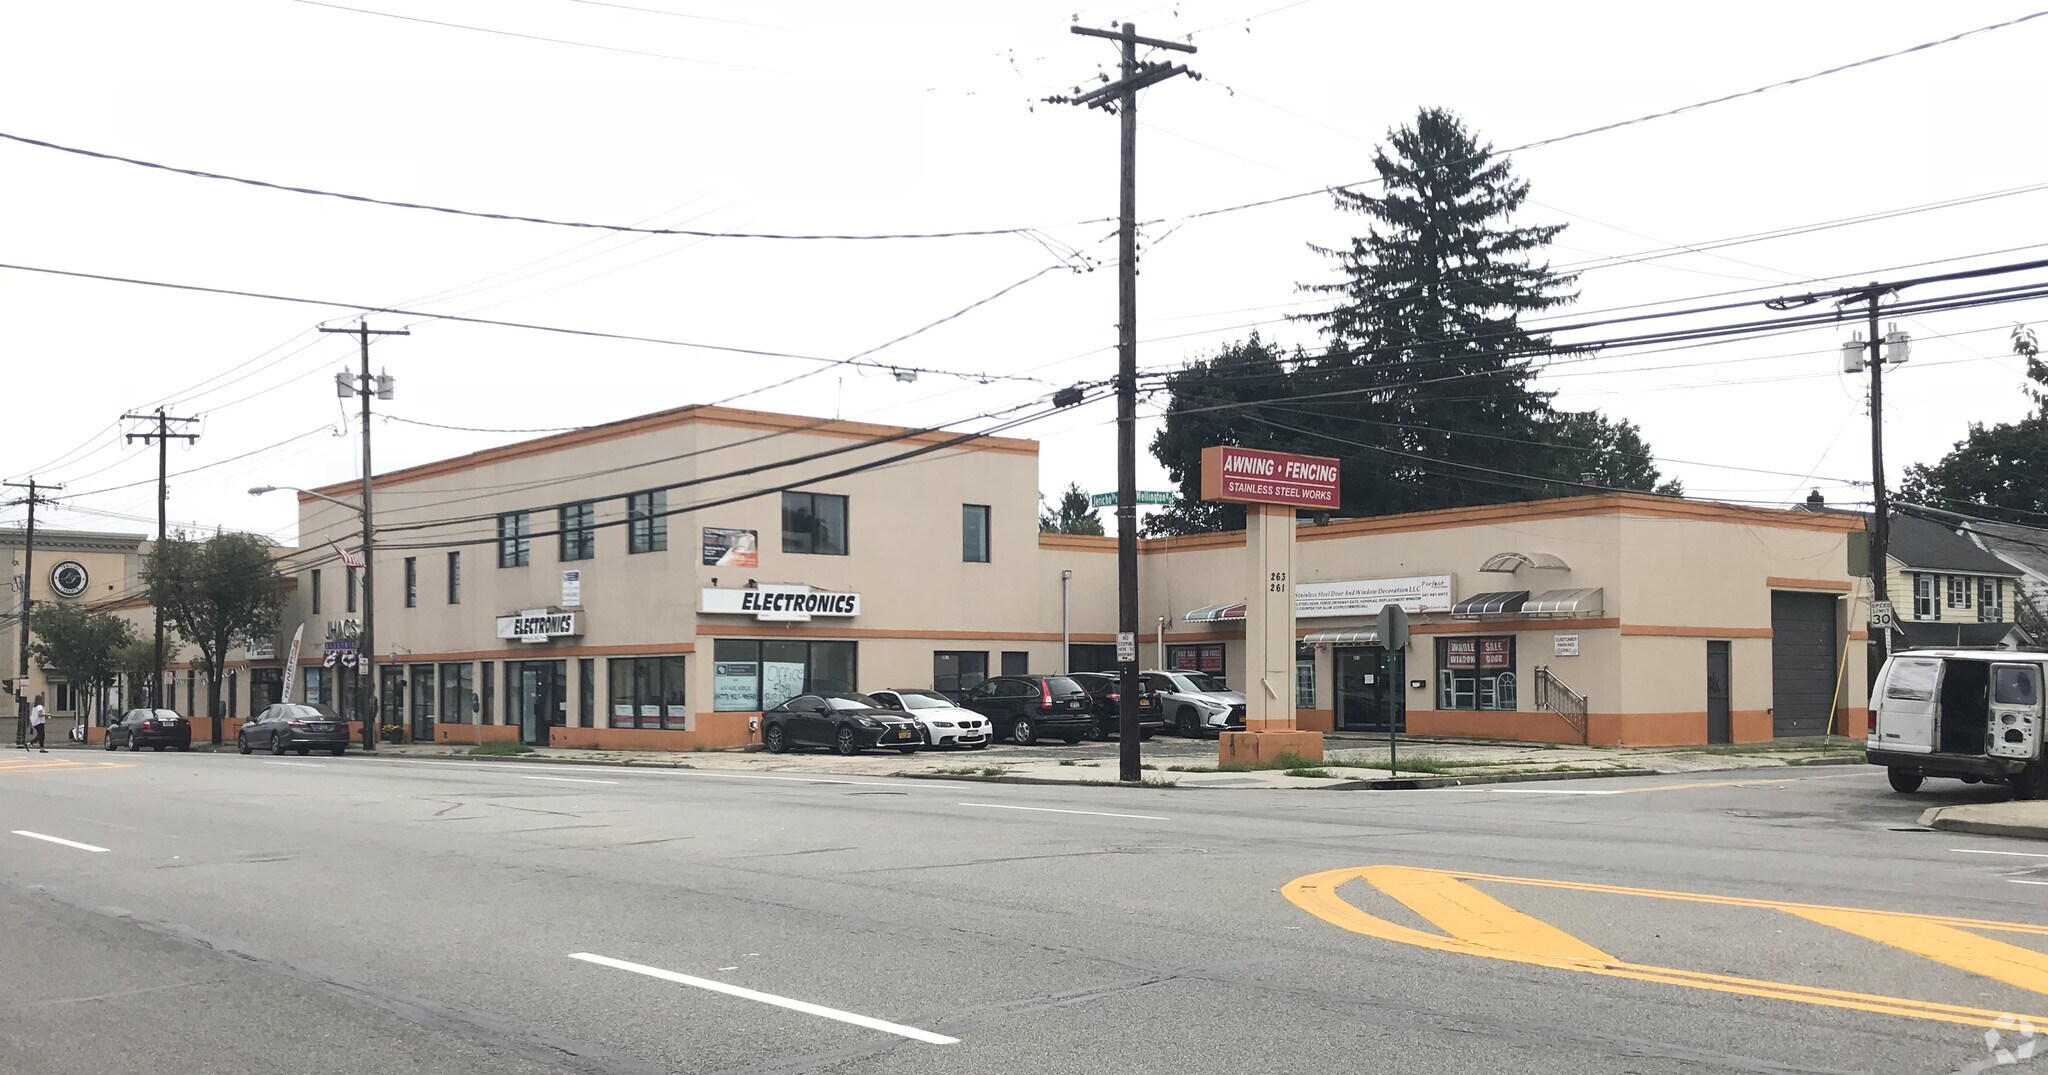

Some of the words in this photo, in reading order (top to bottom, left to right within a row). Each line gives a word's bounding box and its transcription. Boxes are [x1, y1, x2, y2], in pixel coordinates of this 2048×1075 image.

[1224, 455, 1274, 476] AWNING
[1285, 461, 1337, 482] FENCING
[1228, 482, 1273, 495] STAINLESS
[1275, 487, 1300, 498] STEEL
[1302, 489, 1331, 500] WORKS
[1093, 494, 1112, 506] Jericho
[1136, 491, 1166, 504] Wellington
[1270, 572, 1286, 581] 263
[1270, 584, 1285, 592] 261
[742, 592, 856, 613] ELECTRONICS
[514, 615, 572, 635] ELECTRONICS
[1872, 614, 1890, 624] 30
[1451, 642, 1475, 652] WHOLE
[1485, 642, 1503, 651] SALE
[1450, 655, 1475, 664] WINDOW
[1486, 654, 1503, 663] DOOR
[767, 665, 805, 683] Office
